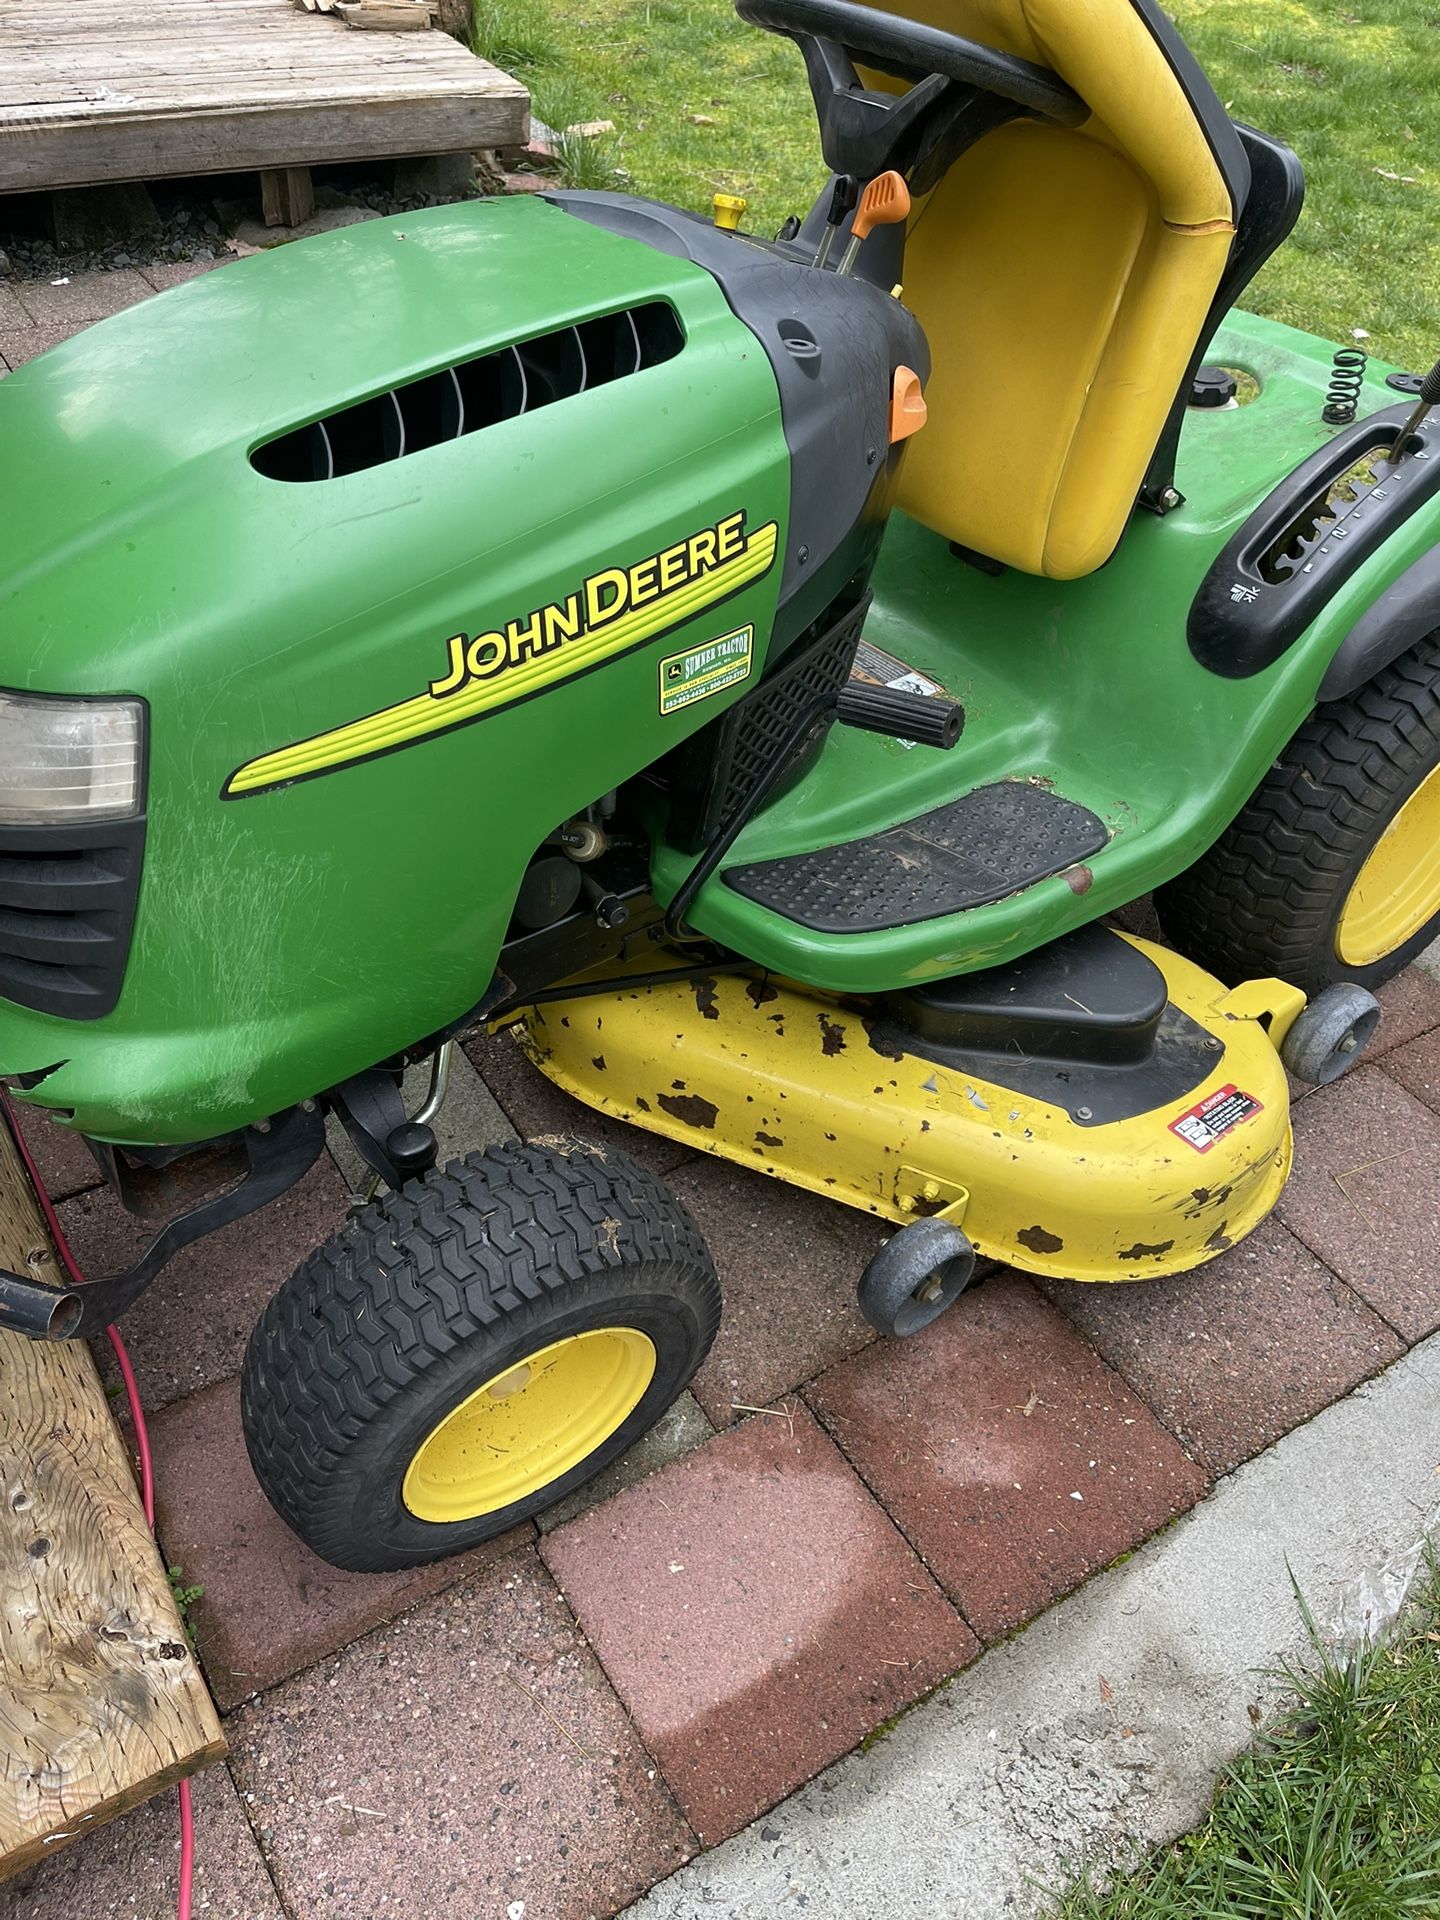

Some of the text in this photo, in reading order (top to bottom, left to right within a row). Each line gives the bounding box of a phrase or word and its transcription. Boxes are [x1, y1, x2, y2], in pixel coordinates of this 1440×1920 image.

[1370, 488, 1388, 500] 3
[1331, 526, 1349, 540] 2
[430, 511, 745, 698] JOHN DEERE
[685, 633, 748, 680] SUMNER TRACTOR
